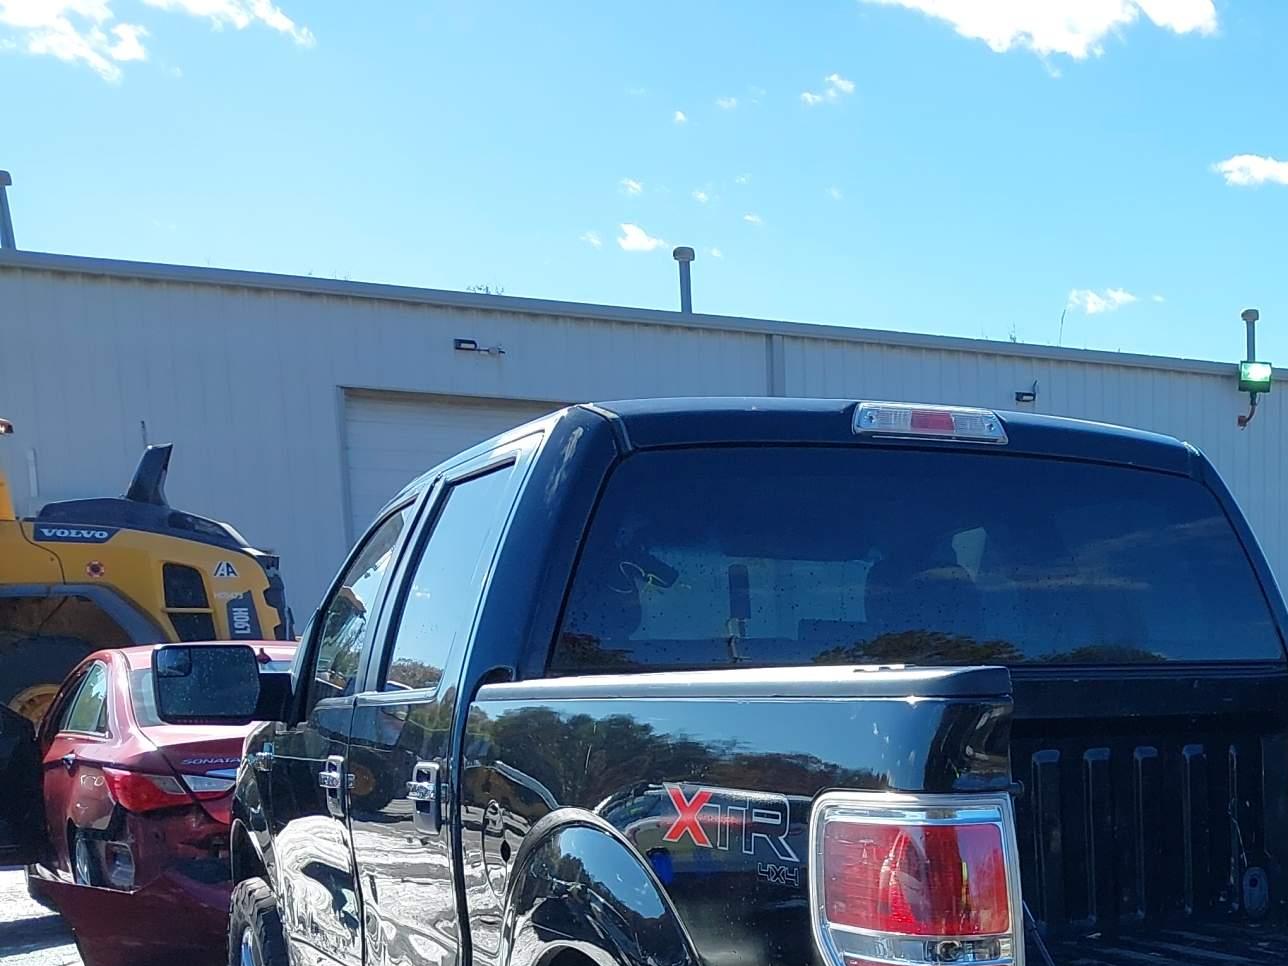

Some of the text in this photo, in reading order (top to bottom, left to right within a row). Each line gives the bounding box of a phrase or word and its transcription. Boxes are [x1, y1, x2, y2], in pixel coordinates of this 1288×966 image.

[40, 528, 108, 539] VOLVO
[231, 607, 252, 634] L90H
[181, 757, 241, 766] SONATA
[662, 782, 800, 863] XTR
